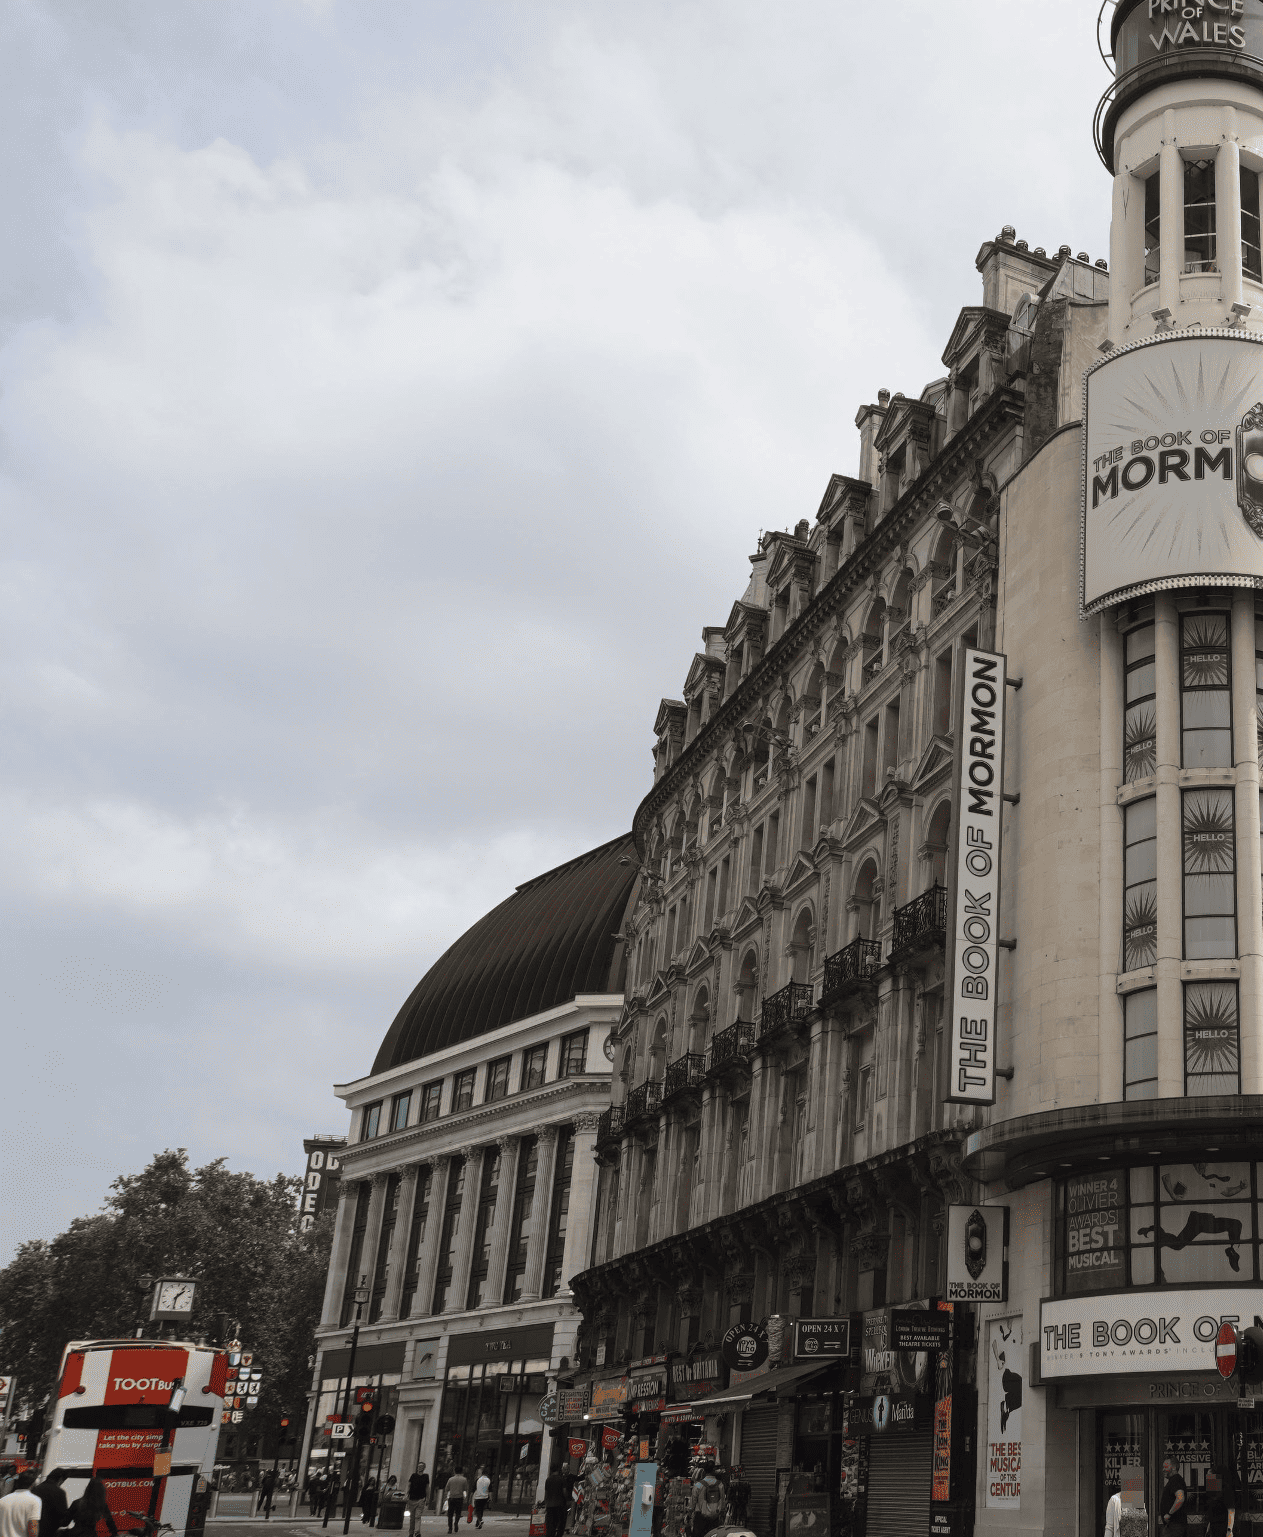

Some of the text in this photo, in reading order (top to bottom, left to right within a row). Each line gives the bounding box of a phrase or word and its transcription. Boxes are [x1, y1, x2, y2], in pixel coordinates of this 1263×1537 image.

[1182, 7, 1203, 18] OF
[1149, 20, 1246, 50] WALES
[1093, 429, 1231, 472] THE BOOK OF
[1190, 654, 1221, 663] HELLO
[1130, 740, 1153, 755] HELLO
[1193, 833, 1225, 842] HELLO
[958, 654, 999, 1093] THE BOOK OF MORMON
[1130, 925, 1154, 938] HELLO
[1195, 1030, 1228, 1039] HELLO
[300, 1150, 324, 1233] ODEO
[1069, 1178, 1118, 1198] WINNER 4
[1069, 1192, 1118, 1214] OLIVIER
[1069, 1224, 1119, 1253] BEST
[1069, 1250, 1119, 1270] MUSICAL
[949, 1289, 1000, 1299] MORMON
[725, 1324, 746, 1343] OPEN
[748, 1324, 759, 1333] 24
[802, 1325, 822, 1333] OPEN
[823, 1325, 832, 1333] 24
[1044, 1322, 1081, 1351] THE
[1092, 1317, 1181, 1347] BOOK
[672, 1364, 685, 1383] BEST
[1149, 1382, 1199, 1398] PRINCE
[1204, 1383, 1221, 1397] OF
[1104, 1457, 1141, 1468] KILLER
[1007, 1473, 1017, 1481] THIS
